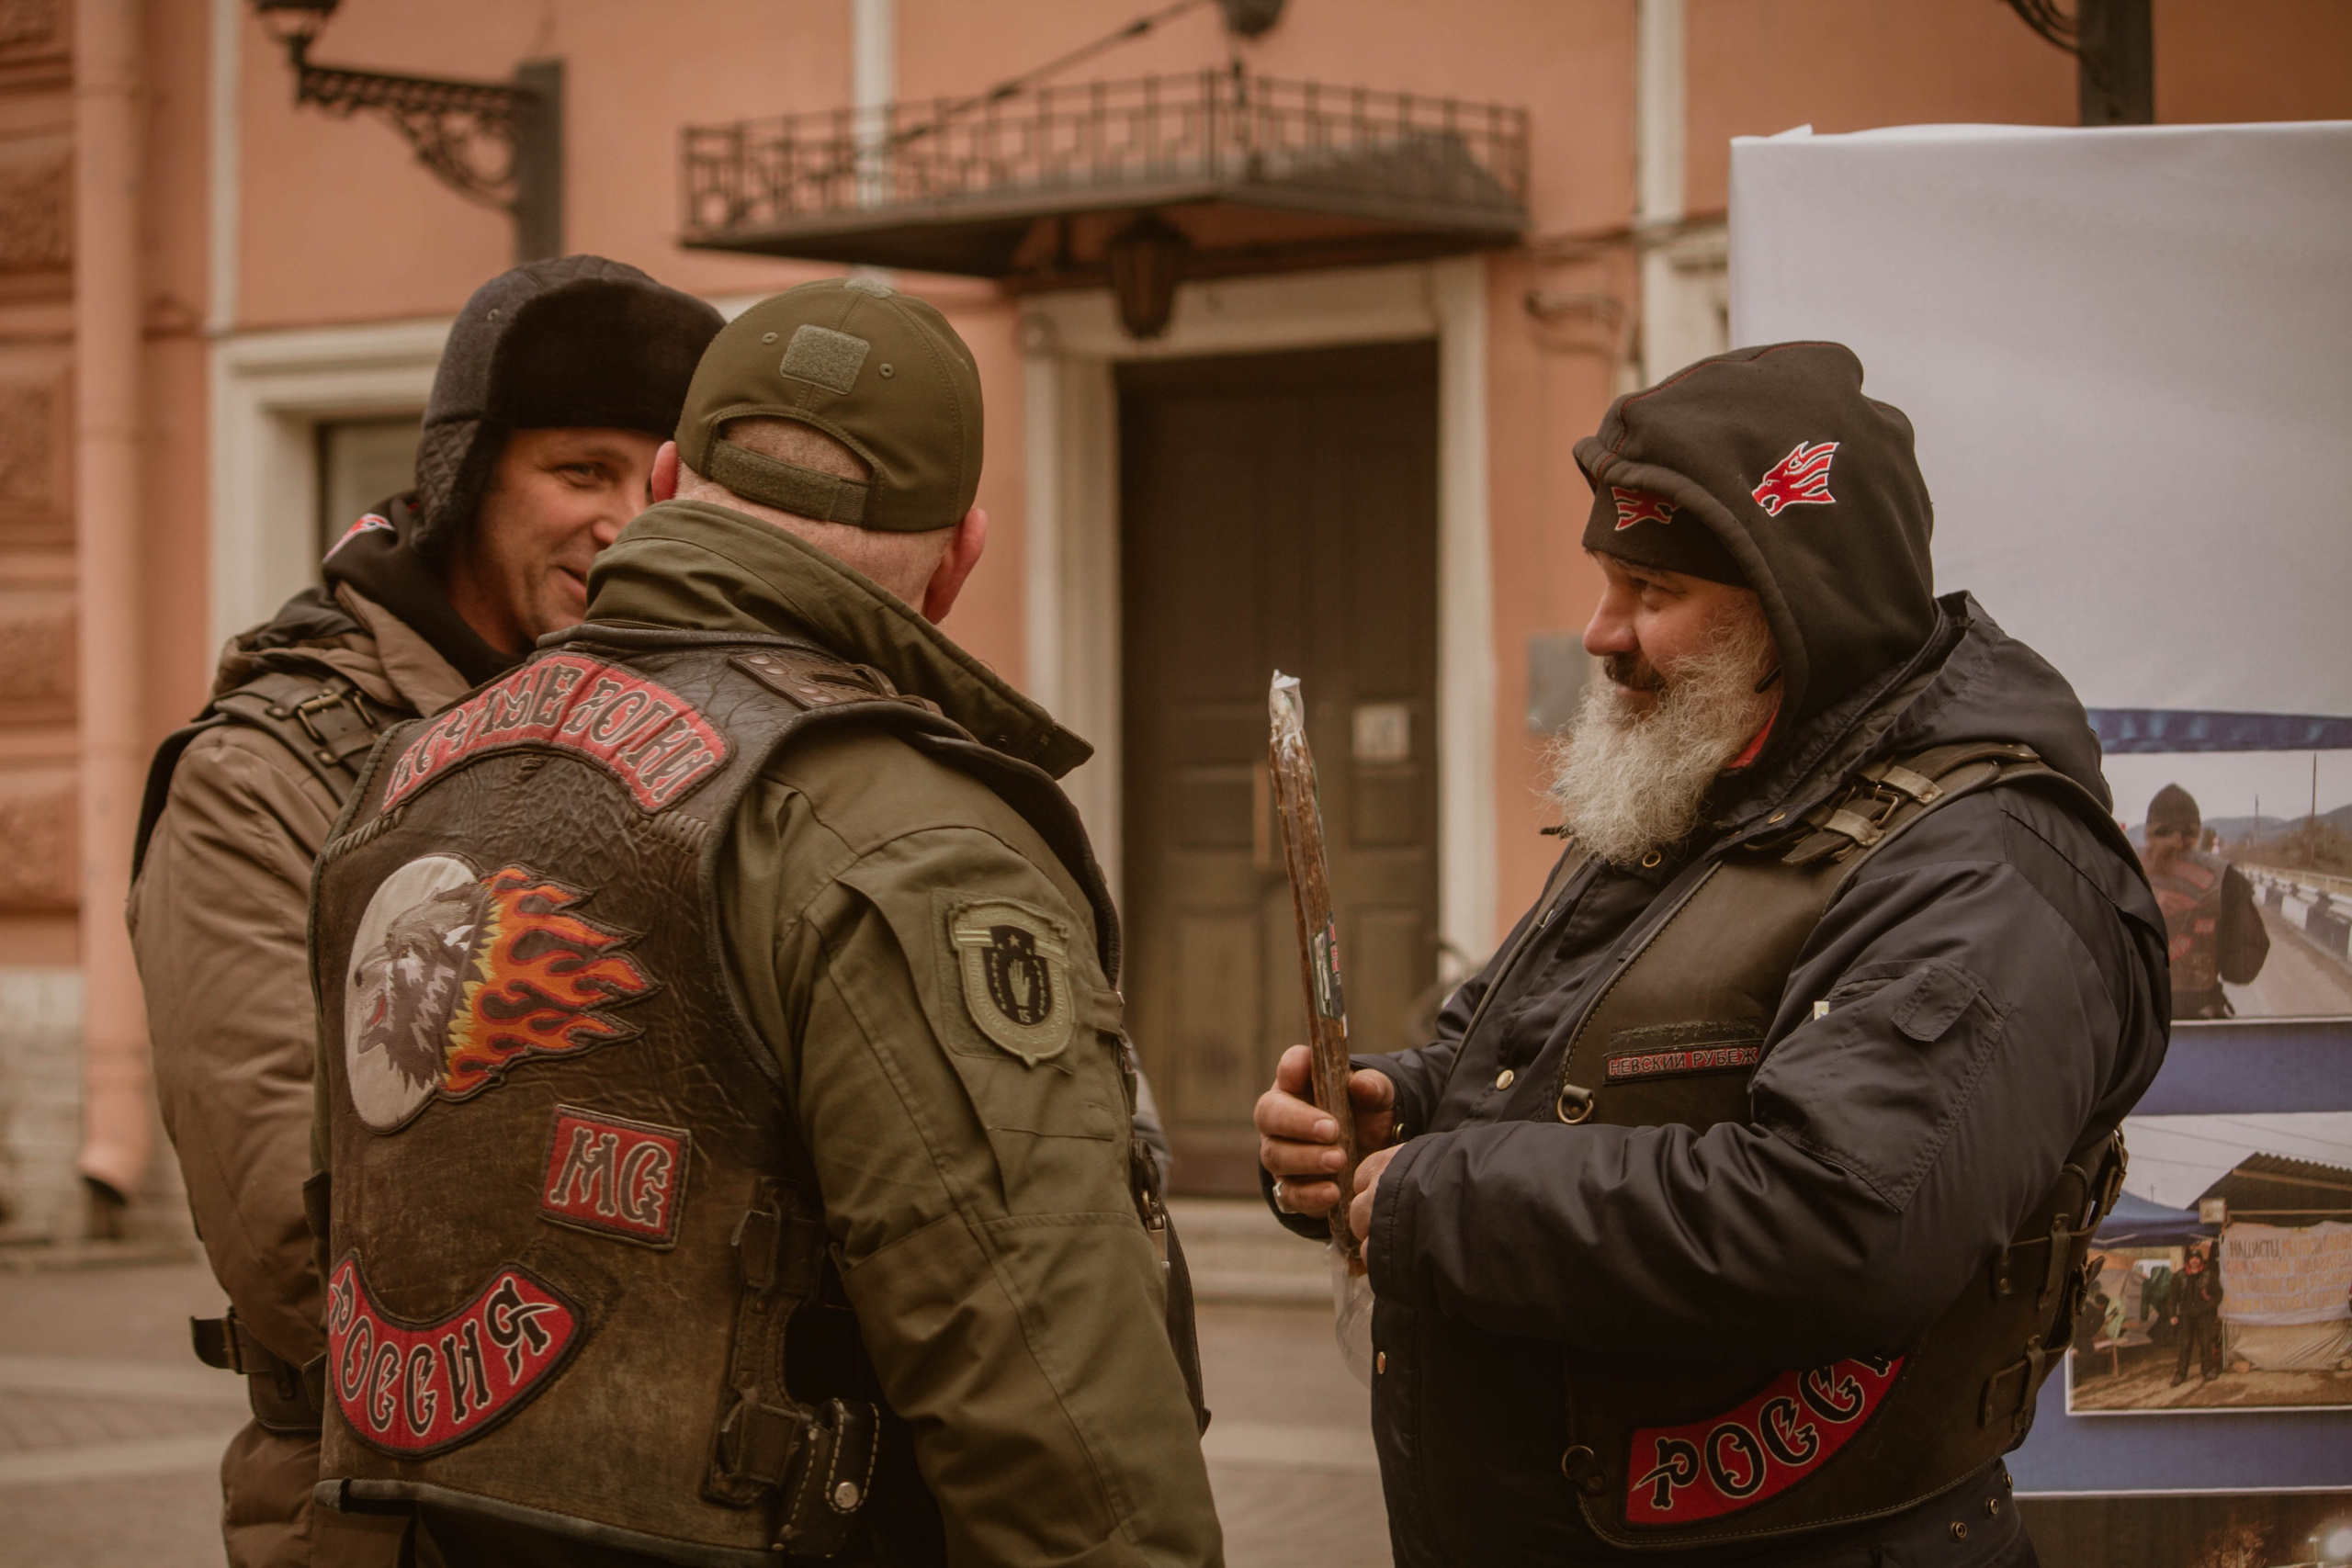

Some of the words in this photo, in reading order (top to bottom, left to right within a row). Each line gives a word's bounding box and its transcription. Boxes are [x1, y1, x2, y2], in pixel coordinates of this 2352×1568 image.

[561, 677, 715, 802] ВОЛКИ
[1691, 1047, 1758, 1067] РУБЕЖ
[330, 1266, 560, 1438] РОССИЯ
[1630, 1355, 1892, 1510] РОСС
